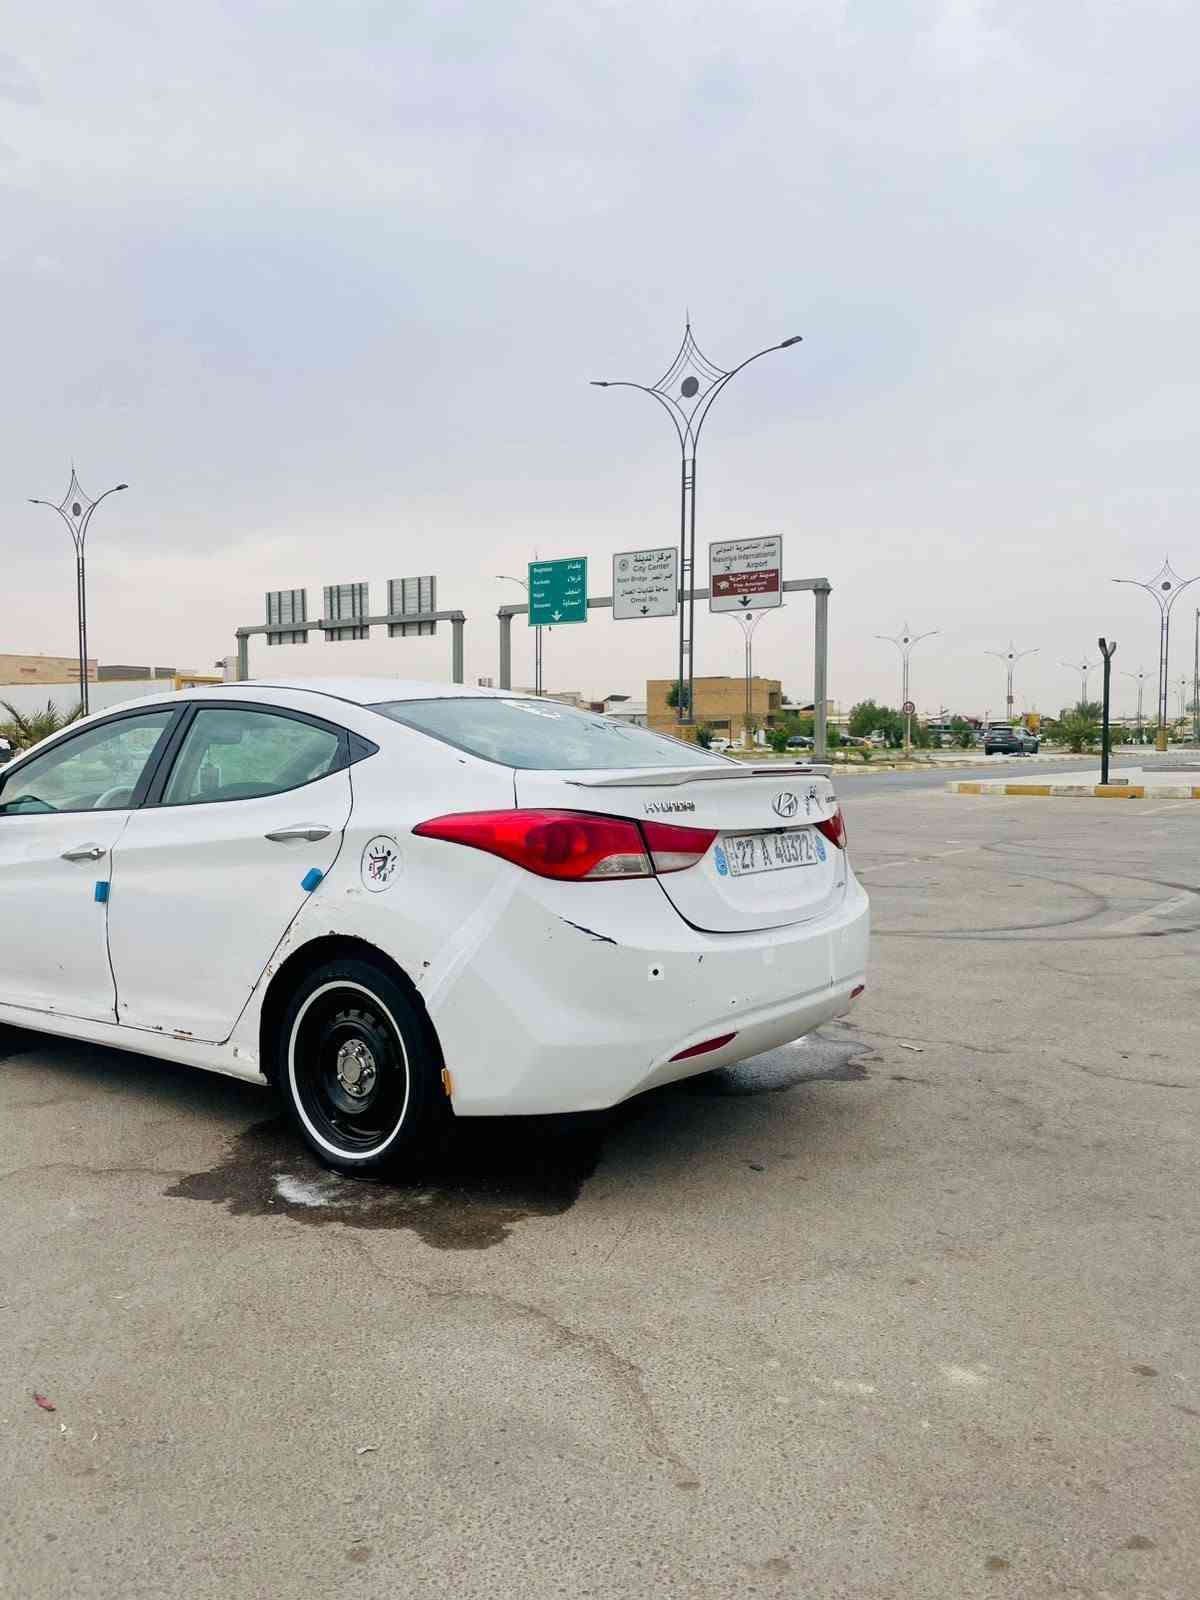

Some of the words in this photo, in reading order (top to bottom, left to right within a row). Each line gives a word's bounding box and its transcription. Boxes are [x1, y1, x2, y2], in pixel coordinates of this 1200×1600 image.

[632, 552, 655, 562] المدينة
[656, 552, 672, 563] مركز
[632, 565, 646, 573] City
[647, 563, 670, 571] Center
[746, 560, 768, 569] Airport
[643, 800, 696, 814] HYUNDAI
[737, 839, 755, 870] 27
[761, 838, 773, 866] A
